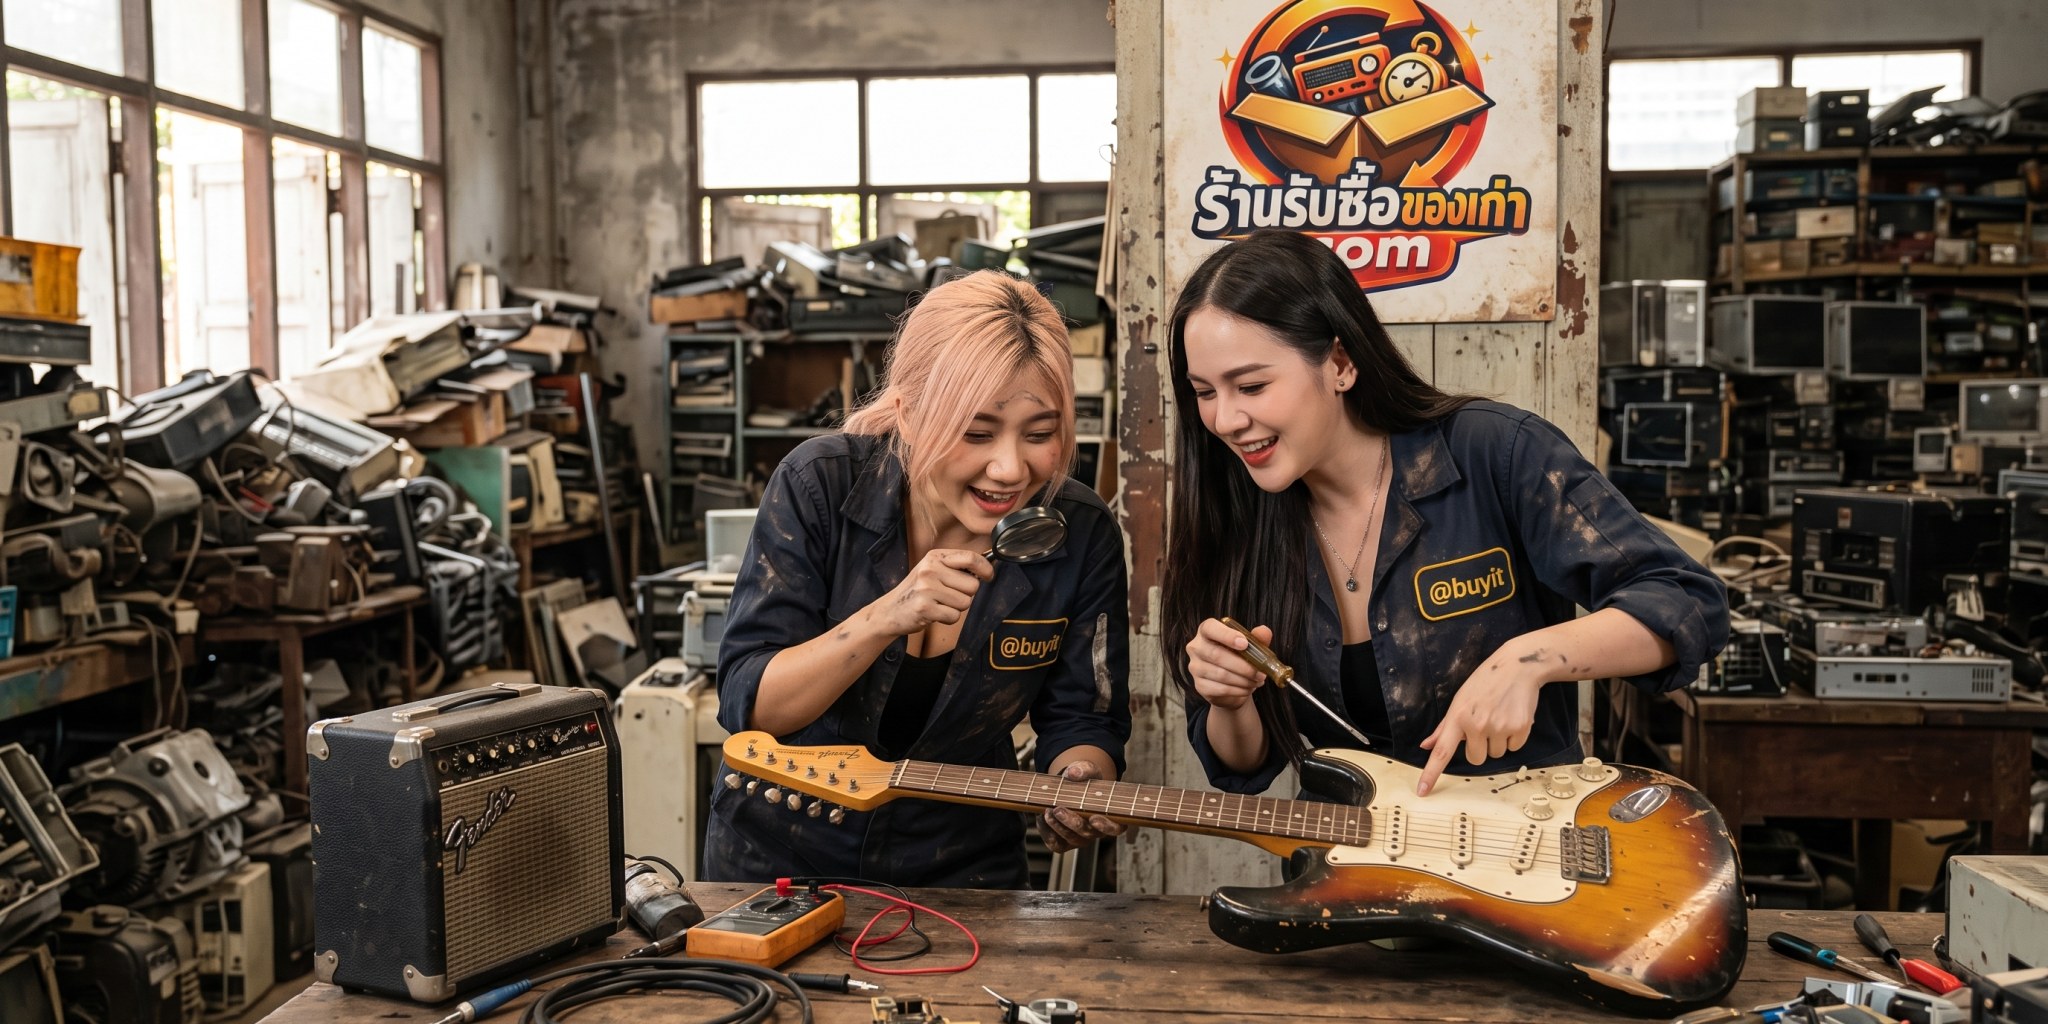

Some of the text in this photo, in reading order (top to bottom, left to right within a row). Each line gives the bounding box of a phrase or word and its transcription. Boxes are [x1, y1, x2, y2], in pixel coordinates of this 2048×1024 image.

[1197, 161, 1527, 231] ร้านรับซื้อของเก่า
[1316, 235, 1431, 270] om
[1429, 567, 1505, 606] @buyit
[1000, 634, 1060, 659] @buyit
